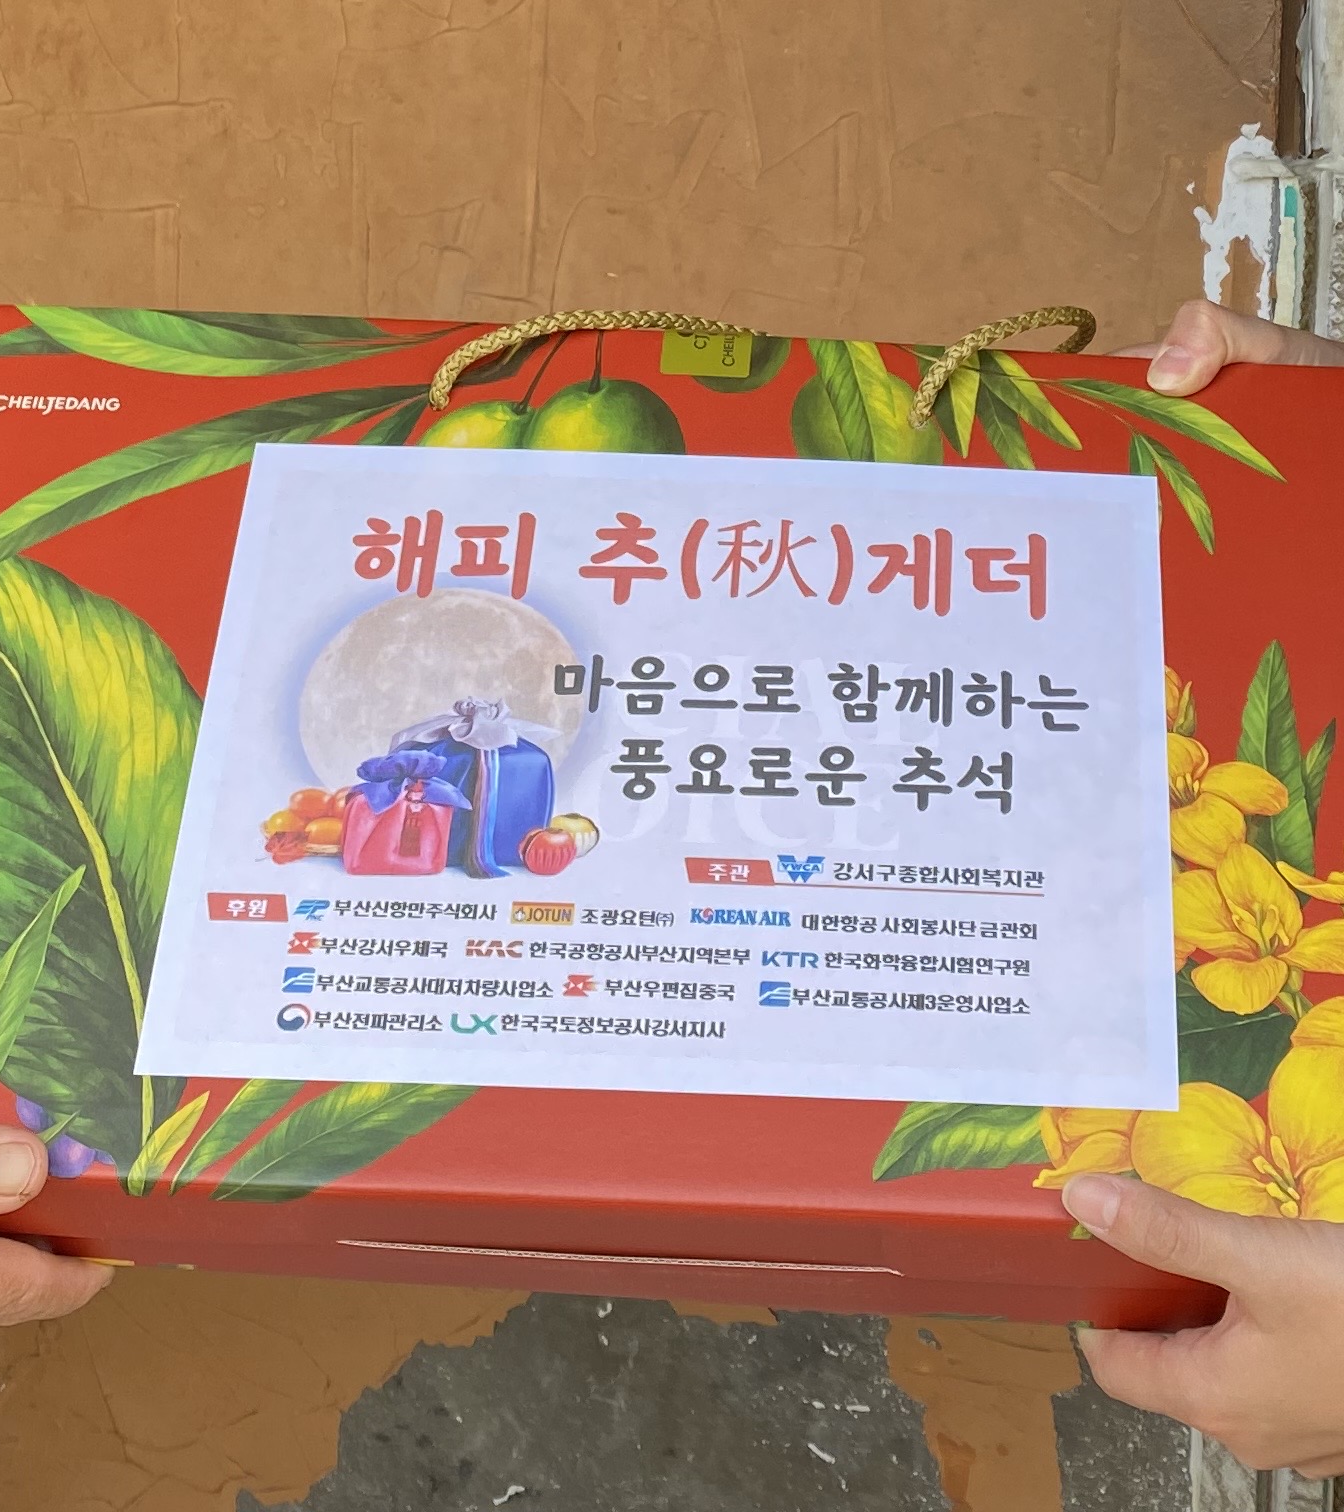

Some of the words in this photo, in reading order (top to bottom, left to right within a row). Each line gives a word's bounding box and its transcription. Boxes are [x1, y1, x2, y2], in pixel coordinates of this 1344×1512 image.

[721, 334, 740, 367] CHEIL
[352, 509, 537, 600] 해피
[578, 512, 1047, 621] 추(秋)게더
[553, 653, 802, 714] 마음으로
[826, 662, 1090, 733] 함께하는
[609, 738, 868, 807] 풍요로운
[891, 745, 1015, 815] 추석
[707, 863, 751, 883] 주관
[832, 862, 1045, 889] 강서구종합사회복지관
[225, 898, 269, 918] 후원
[333, 899, 497, 921] 부산신항만주식회사
[526, 907, 572, 922] JOTUN
[690, 907, 758, 925] KOREAN
[760, 910, 792, 927] AIR
[801, 914, 878, 934] 대한항공
[881, 916, 976, 938] 사회봉사단
[319, 937, 448, 958] 부산강서우체국
[465, 939, 524, 958] KAC
[529, 941, 750, 966] 한국공항공사부산지역본부
[761, 950, 819, 969] KTR
[824, 951, 1031, 977] 한국화학융합시험연구원
[316, 974, 554, 999] 부산교통공사대저차량사업소
[605, 978, 736, 1001] 부산우편집중국
[792, 988, 1031, 1015] 부산교통공사제3운영사업소
[314, 1011, 444, 1032] 부산전파관리소
[501, 1013, 726, 1039] 한국국토정보공사강서지사
